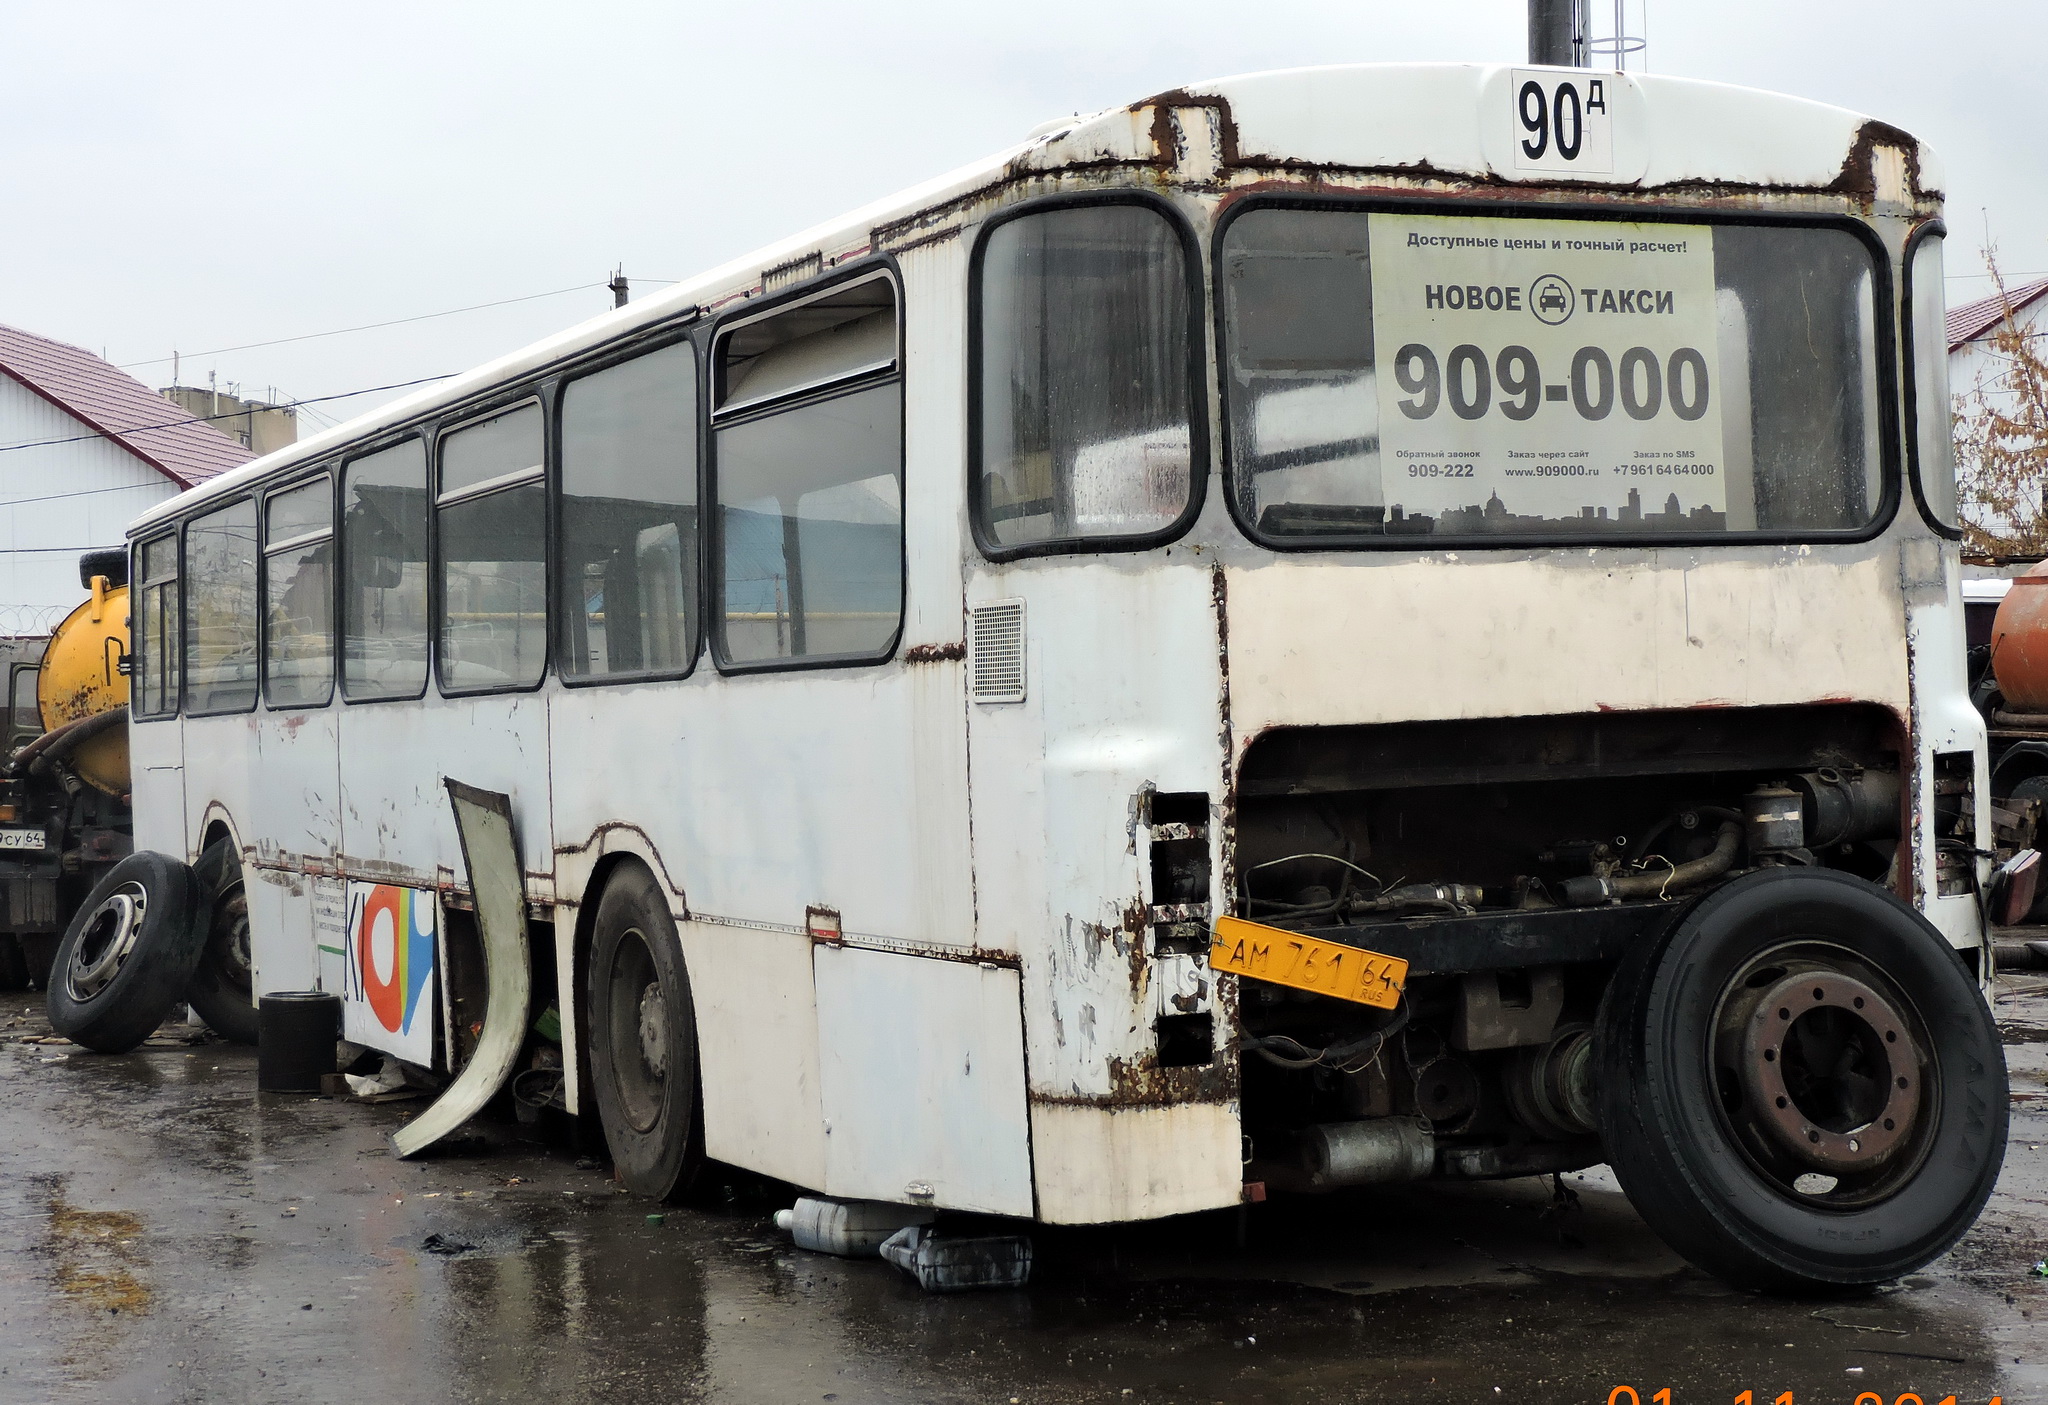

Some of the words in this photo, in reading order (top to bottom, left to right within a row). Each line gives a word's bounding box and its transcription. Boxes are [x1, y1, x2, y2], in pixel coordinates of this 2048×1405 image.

[1407, 232, 1498, 249] Доступные
[1503, 238, 1546, 250] цены
[1551, 240, 1561, 249] и
[1565, 239, 1625, 251] точный
[1629, 241, 1687, 254] расчет!
[1425, 285, 1521, 311] НОВОЕ
[1580, 289, 1674, 314] ТАКСИ
[1394, 343, 1710, 421] 909-000
[1396, 450, 1445, 459] Обратный
[1507, 450, 1536, 458] Заказ
[1538, 452, 1566, 460] через
[1568, 450, 1589, 458] сайт
[1408, 464, 1474, 477] 909-222
[1505, 465, 1600, 476] www.909000.ru
[26, 832, 40, 843] 64
[1283, 940, 1343, 989] 761
[1362, 959, 1392, 990] 64
[1359, 987, 1383, 1002] RUS
